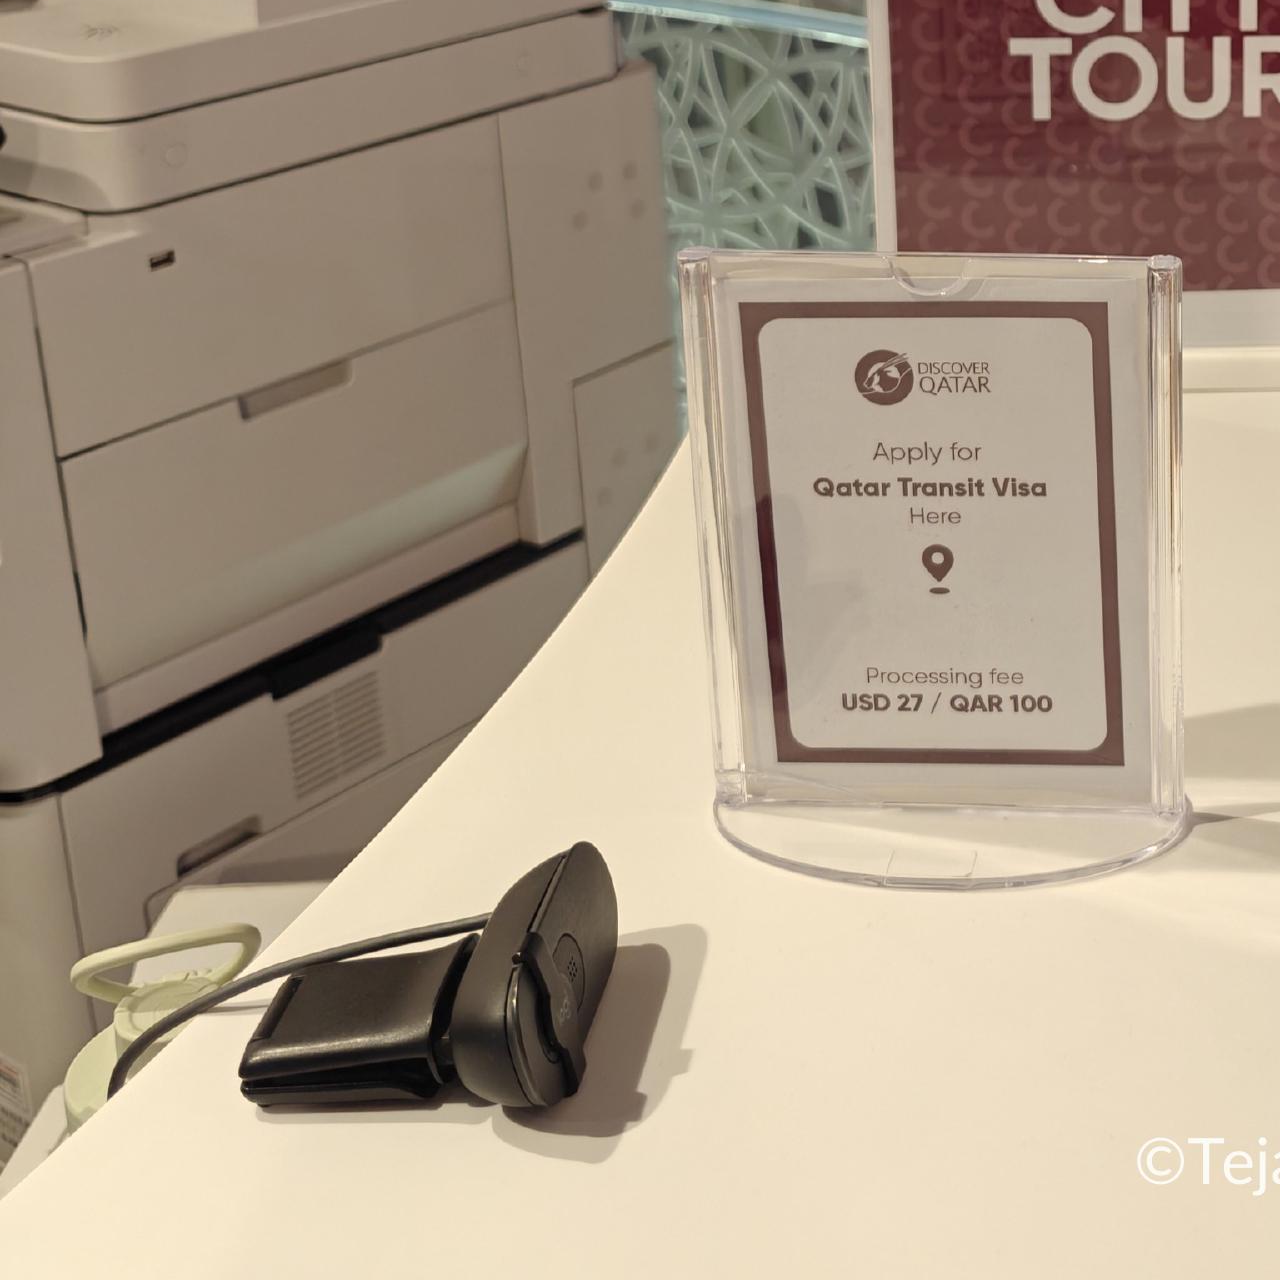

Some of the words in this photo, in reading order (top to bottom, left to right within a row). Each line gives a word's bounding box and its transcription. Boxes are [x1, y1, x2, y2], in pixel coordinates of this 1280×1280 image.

[917, 361, 990, 376] DISCOVER
[919, 376, 991, 395] QATAR
[872, 441, 943, 466] Apply
[949, 441, 982, 462] for
[812, 477, 891, 498] Qatar
[896, 477, 985, 498] Transit
[992, 477, 1048, 498] Visa
[909, 506, 962, 525] Here
[866, 667, 983, 689] Processing
[988, 667, 1024, 685] fee
[841, 693, 891, 712] USD
[896, 693, 924, 712] 27
[929, 691, 942, 714] /
[949, 693, 1004, 714] QAR
[1009, 694, 1054, 713] 100
